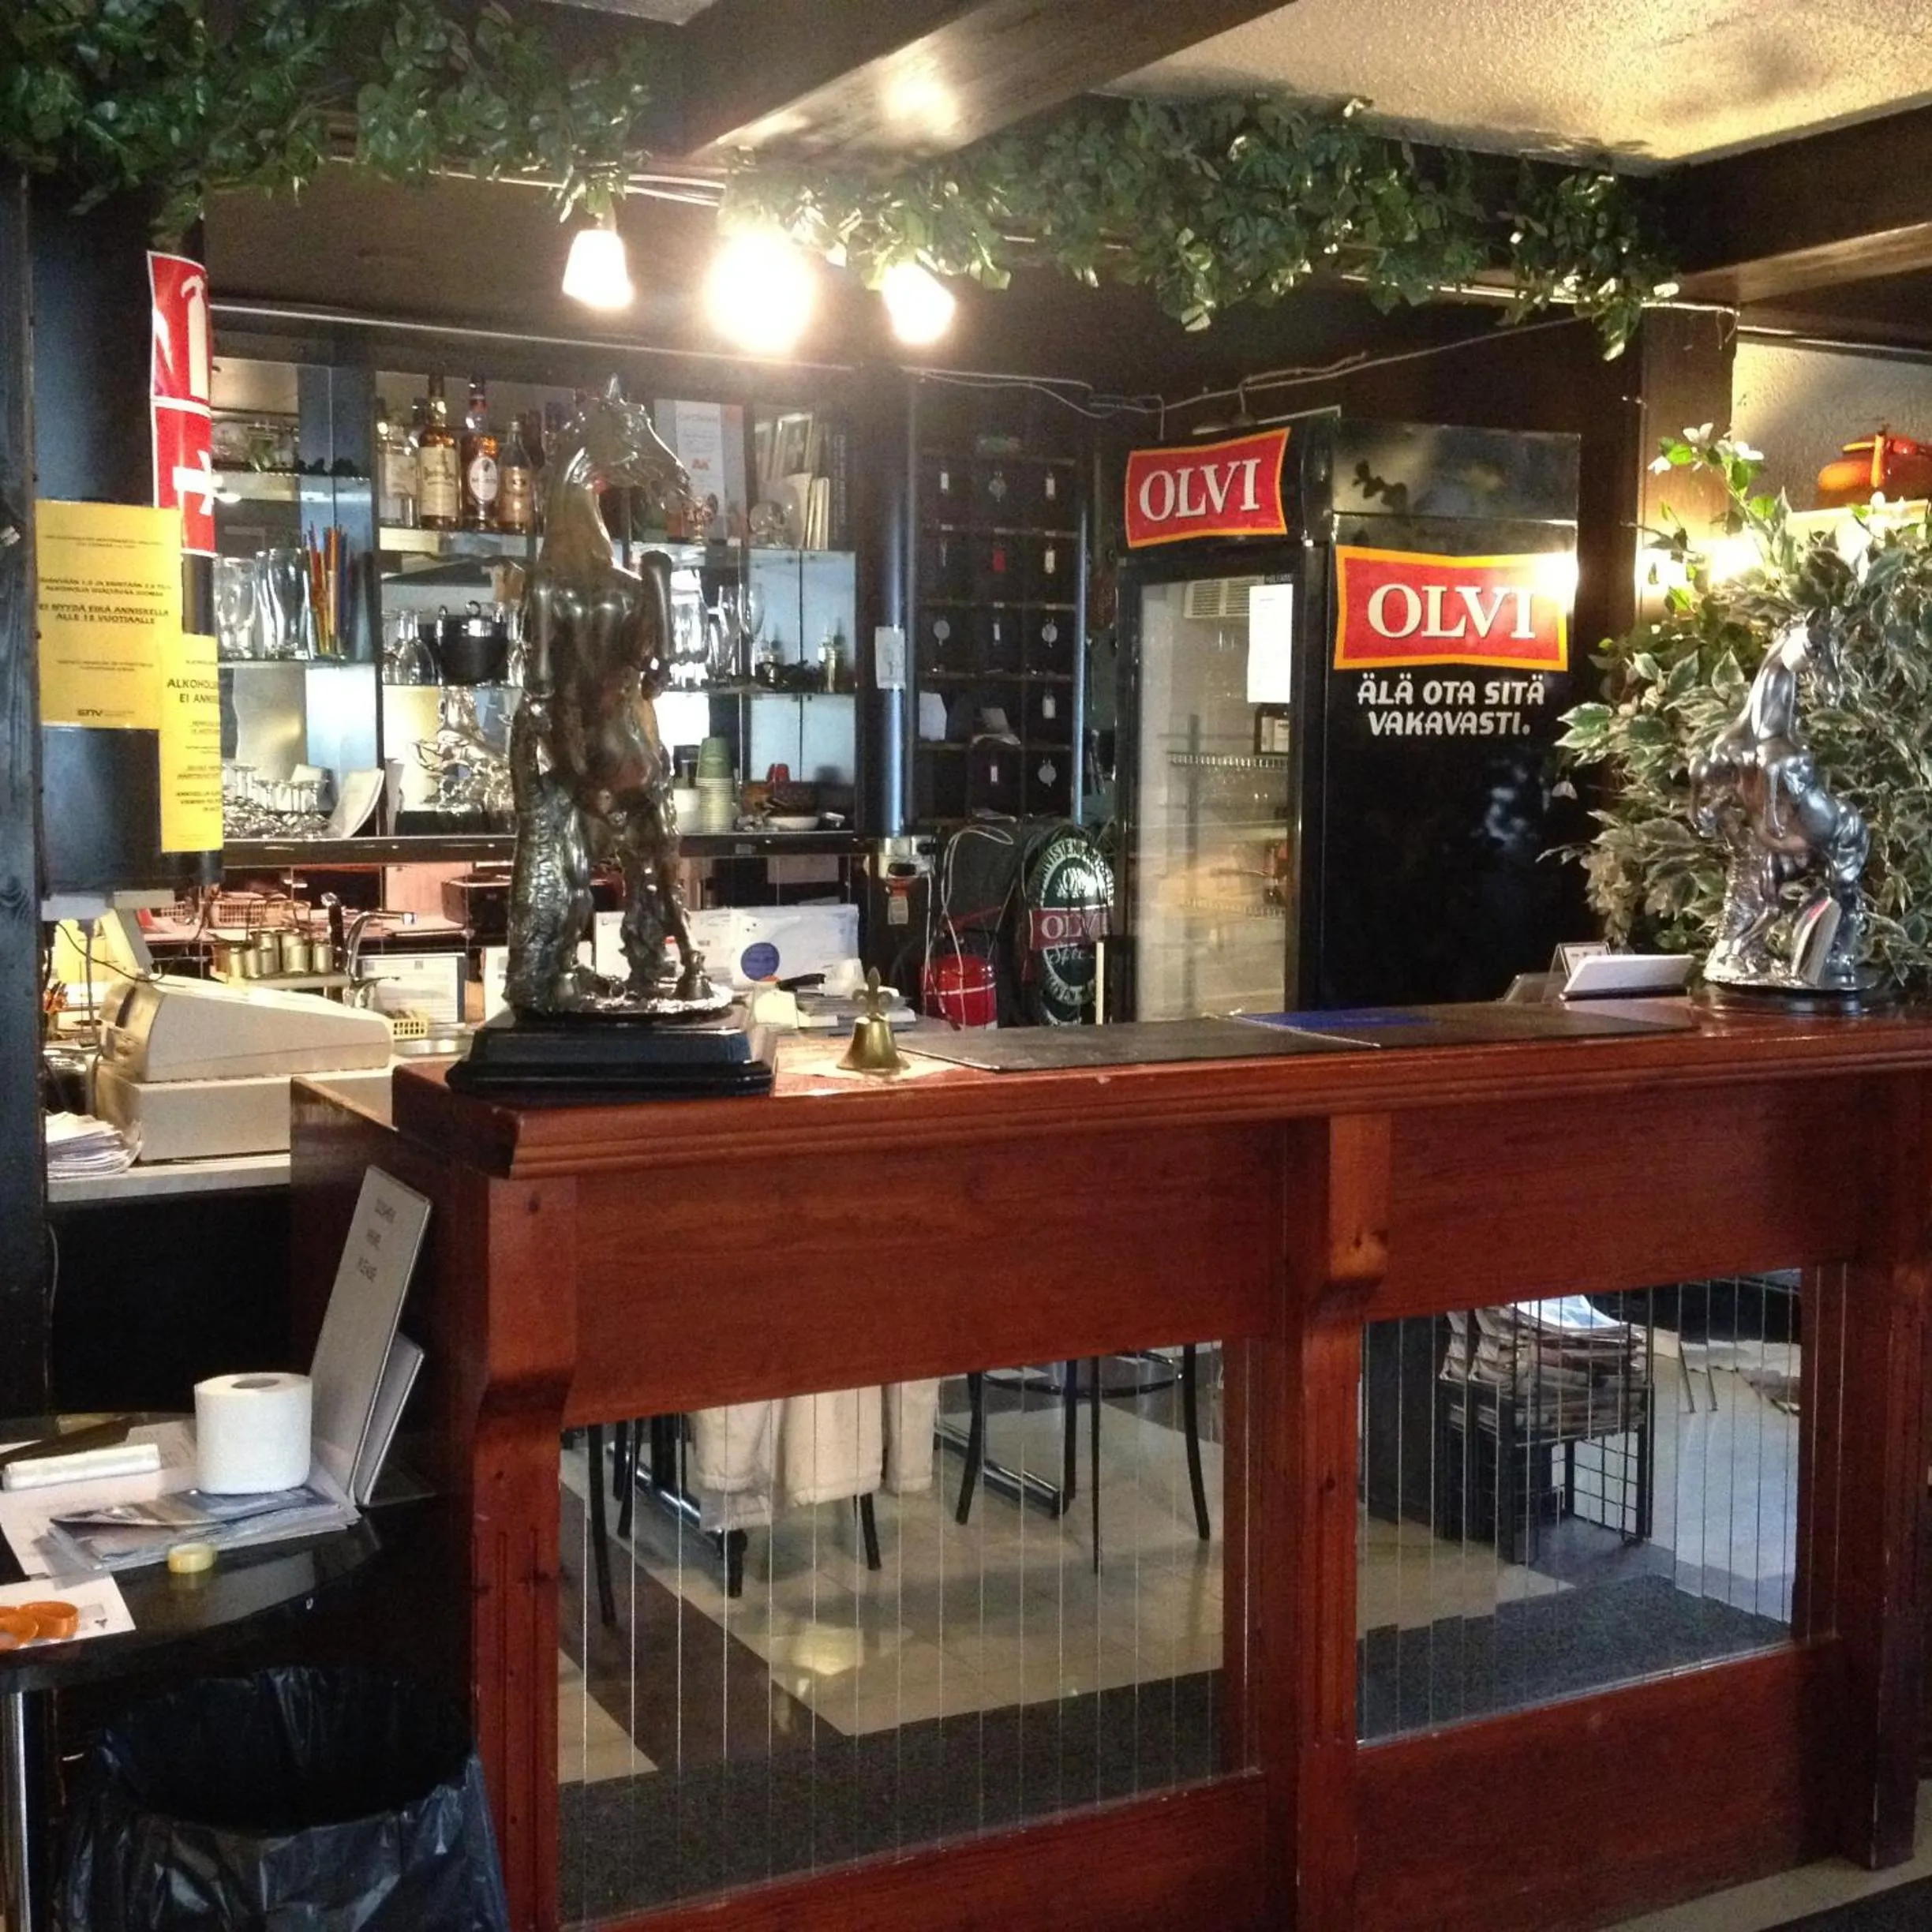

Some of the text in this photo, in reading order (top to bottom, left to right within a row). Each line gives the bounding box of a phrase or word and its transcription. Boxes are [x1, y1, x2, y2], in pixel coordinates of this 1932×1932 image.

[1139, 458, 1261, 522] OLVI
[56, 612, 80, 621] ALLE
[1368, 583, 1536, 640] OLVI
[179, 694, 189, 703] EI
[1357, 672, 1544, 706] ÄLÄ OTA SITÄ
[1368, 711, 1530, 736] VAKAVASTI.
[1041, 912, 1107, 940] OLVI
